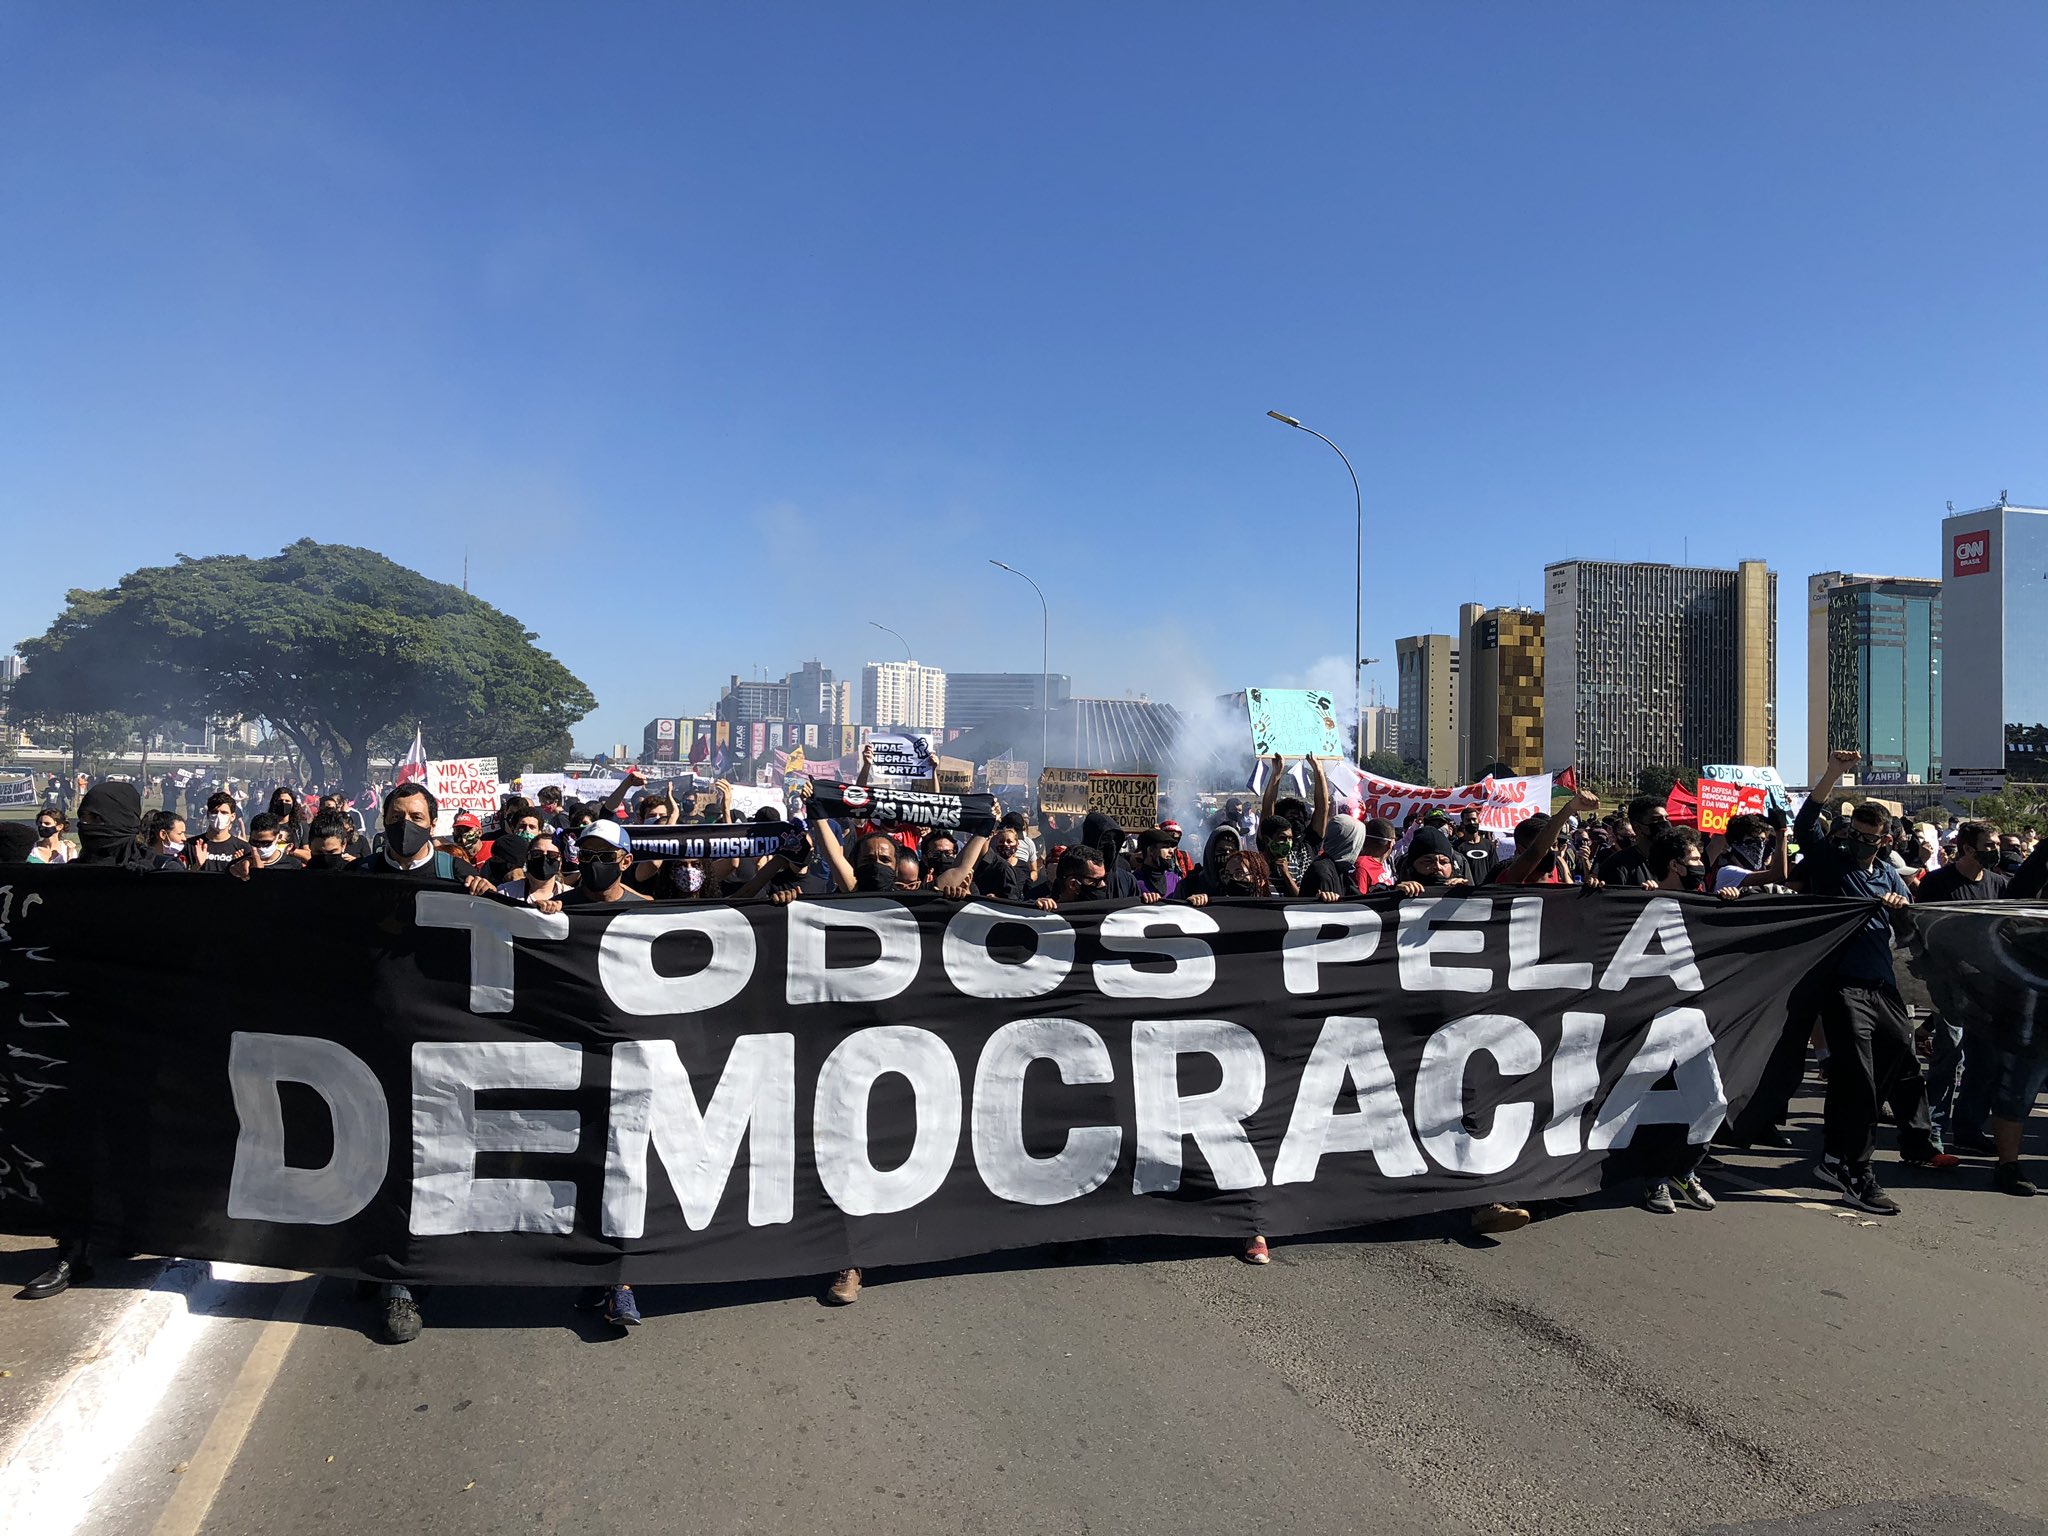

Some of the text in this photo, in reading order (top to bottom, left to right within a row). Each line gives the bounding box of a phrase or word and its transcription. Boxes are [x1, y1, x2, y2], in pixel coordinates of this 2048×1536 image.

[1957, 541, 1984, 559] CNN
[1960, 558, 1981, 566] BRASIL
[872, 743, 903, 752] VIDAS
[436, 763, 479, 779] VIDAS
[874, 765, 925, 775] MPORTAM
[1048, 771, 1055, 781] A
[1875, 773, 1901, 781] ANFIP
[439, 780, 496, 795] NEGRAS
[1090, 779, 1156, 795] TERRORISMO
[1711, 787, 1732, 796] DEFESA
[436, 797, 496, 813] MPORTAM
[873, 788, 962, 806] #RESPEITA
[1045, 794, 1064, 802] SER
[1701, 793, 1738, 803] DEMOCRACIA
[871, 801, 962, 828] AS MINAS
[1364, 795, 1400, 820] ÃO
[632, 834, 780, 858] VINDO AO HOSPÍCIO
[414, 890, 1704, 1015] TODOS PELA
[228, 1005, 1728, 1239] DEMOCRACIA
